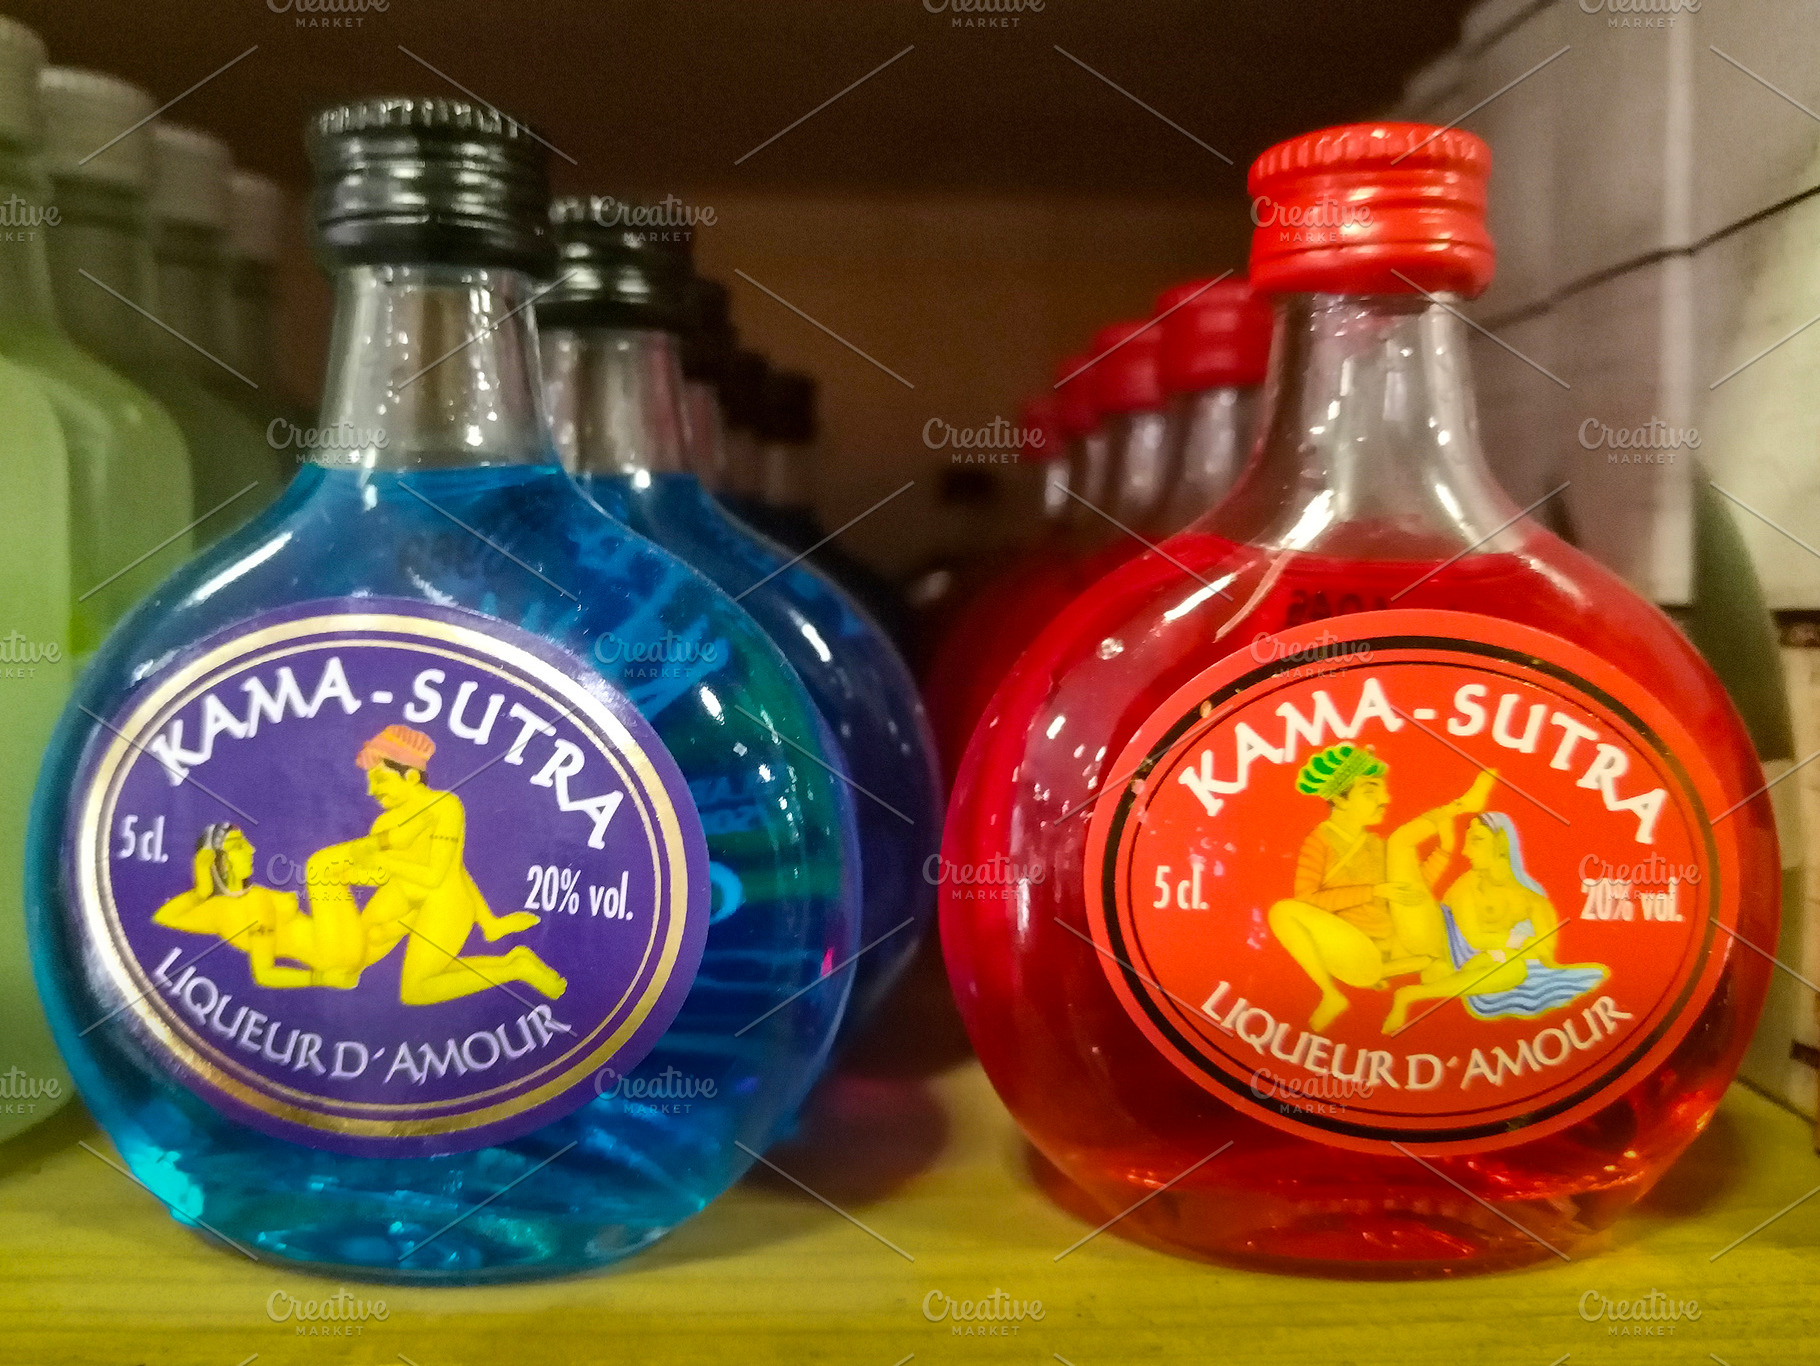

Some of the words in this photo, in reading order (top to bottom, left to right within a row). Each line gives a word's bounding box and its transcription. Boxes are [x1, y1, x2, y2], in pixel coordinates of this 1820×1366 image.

[523, 864, 581, 914] 20%
[588, 870, 634, 921] vol.
[154, 947, 326, 1075] LIQUEUR
[1201, 980, 1399, 1089] LIQUEUR
